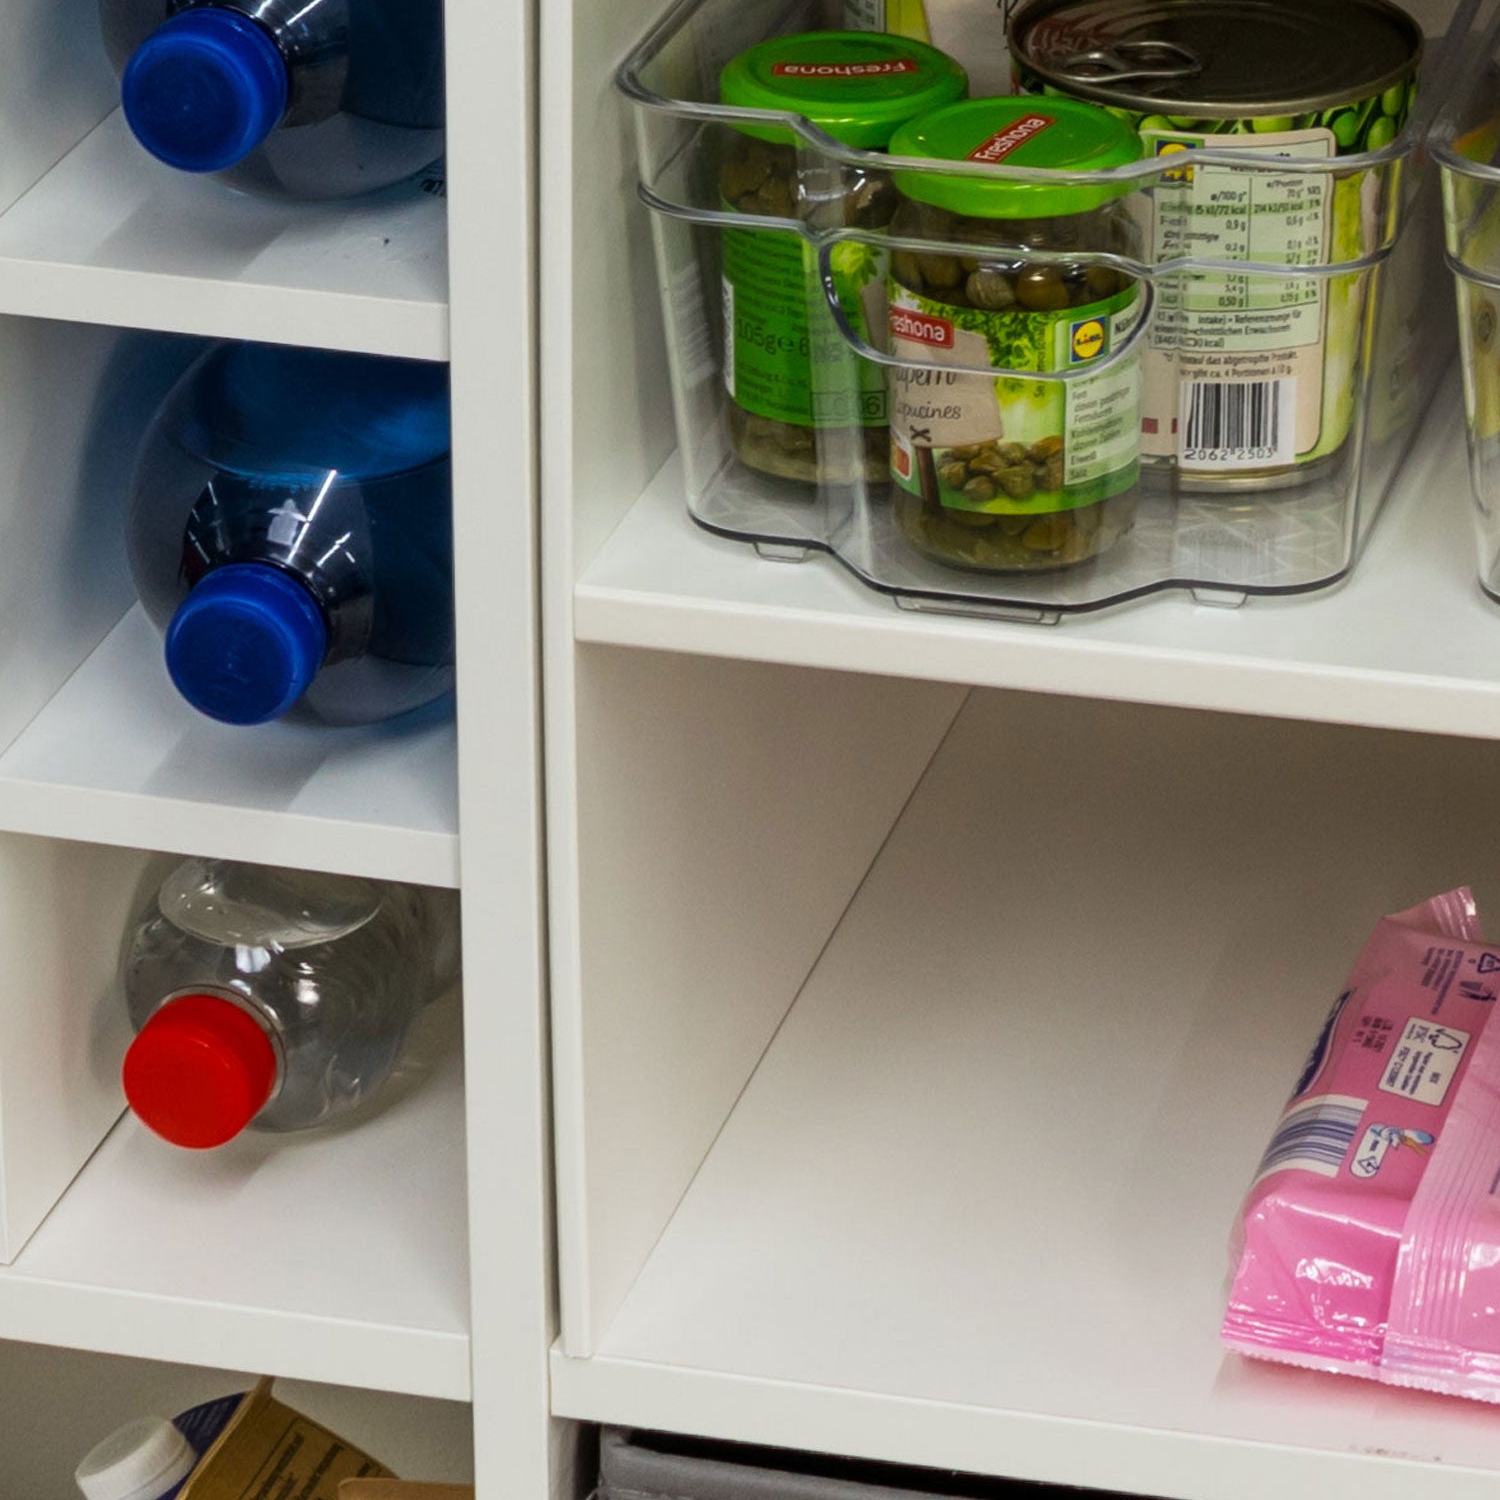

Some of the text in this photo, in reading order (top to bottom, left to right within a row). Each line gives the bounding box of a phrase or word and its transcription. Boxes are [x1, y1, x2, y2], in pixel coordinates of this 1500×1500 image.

[784, 60, 907, 76] Freshona
[974, 117, 1045, 161] Freshona
[1184, 448, 1274, 461] 2062 2503
